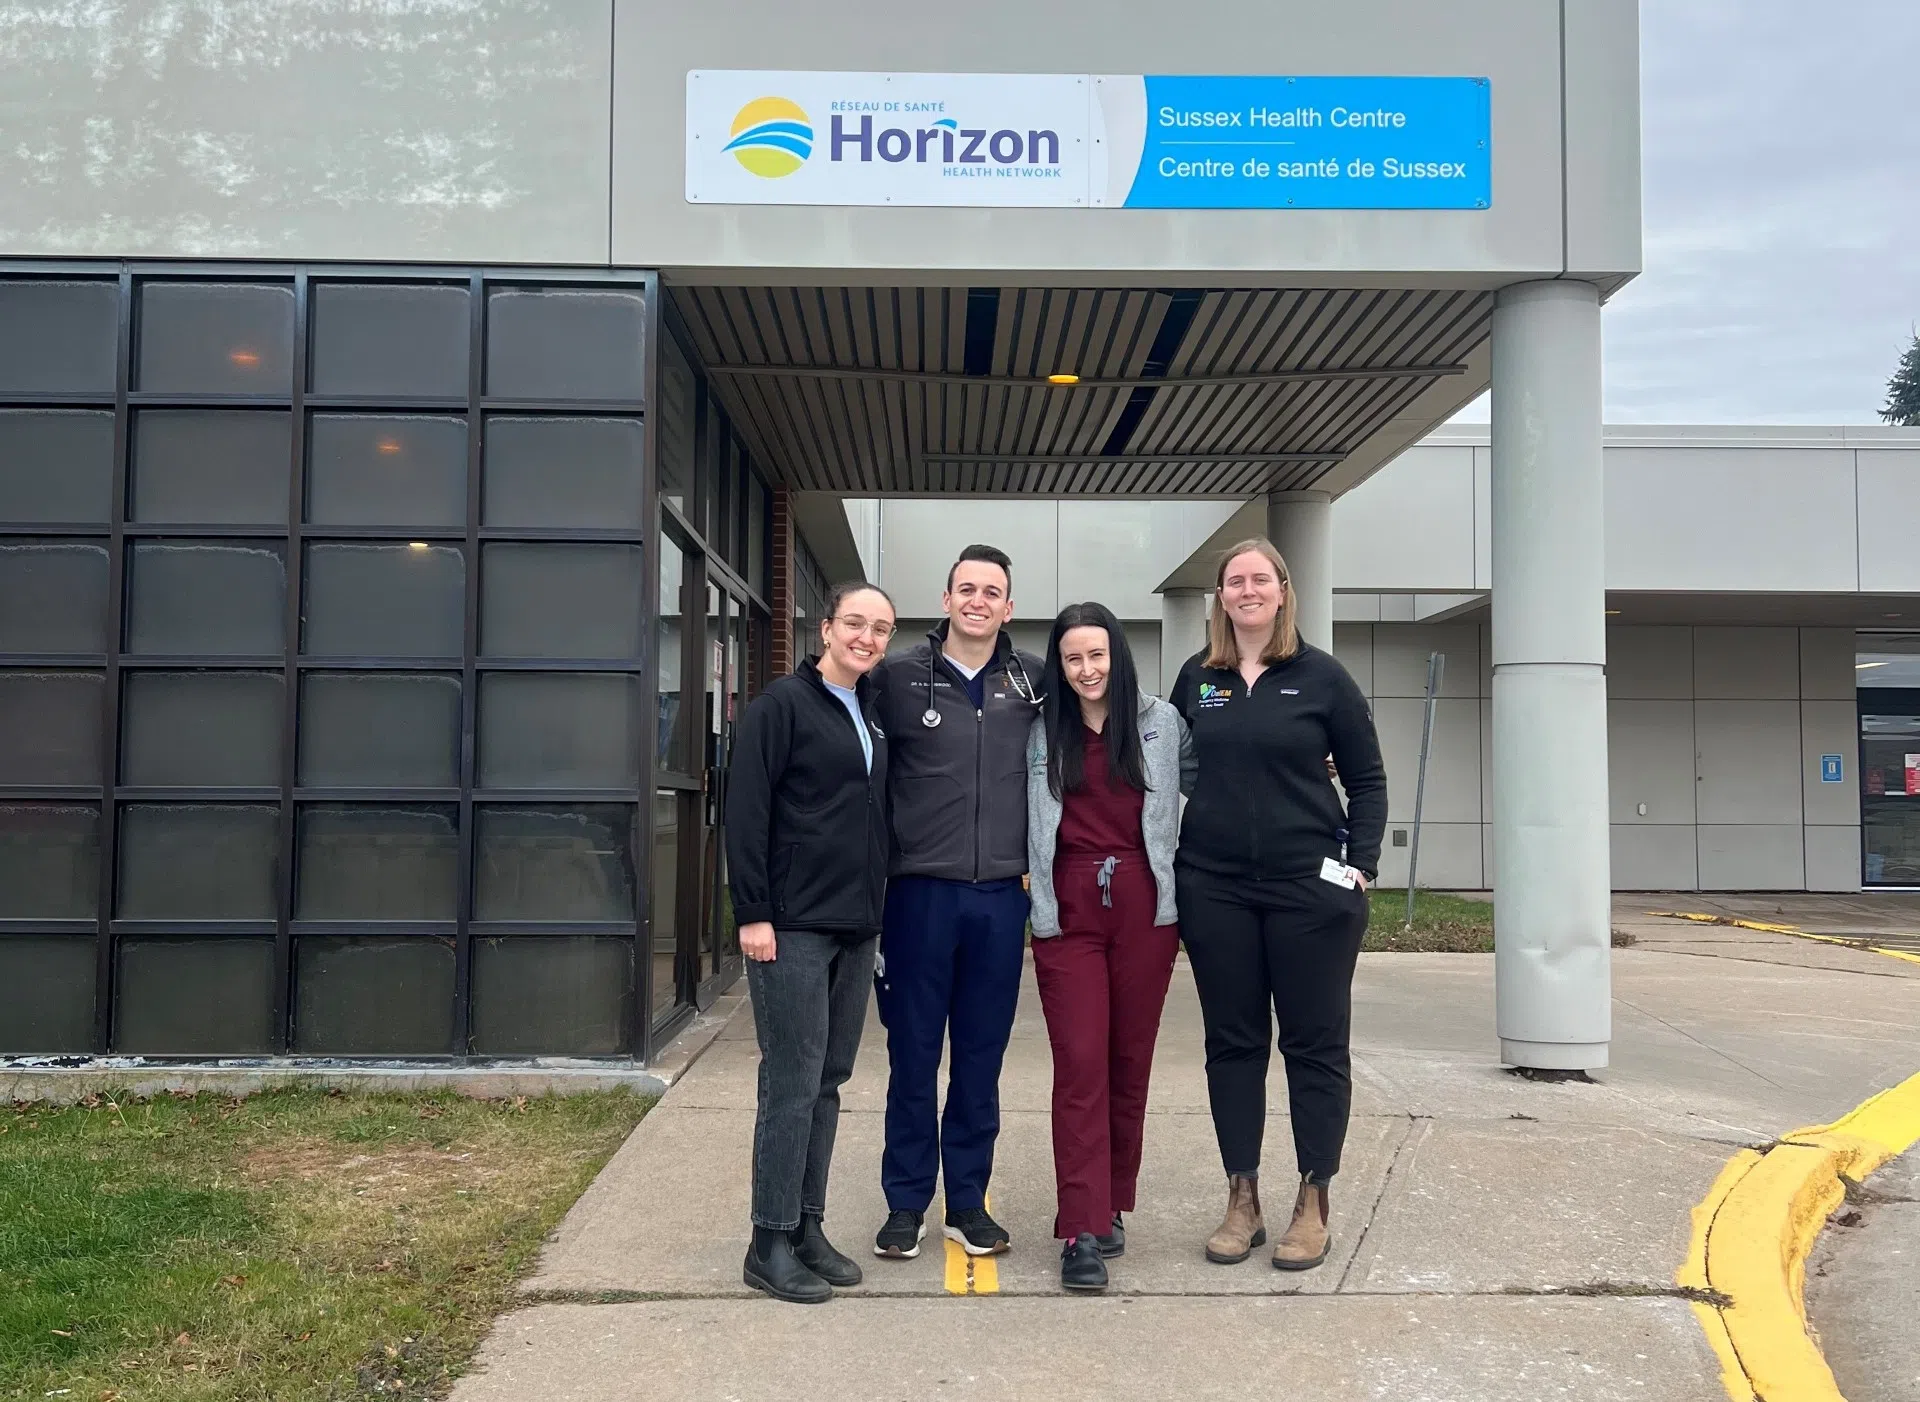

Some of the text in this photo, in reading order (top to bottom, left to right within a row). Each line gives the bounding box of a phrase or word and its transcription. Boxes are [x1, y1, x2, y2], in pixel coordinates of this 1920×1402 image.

[831, 100, 945, 113] RÉSEAU DE SANTÉ
[1159, 106, 1406, 128] Sussex Health Centre
[831, 115, 1059, 164] Horizon
[942, 167, 1062, 178] HEALTH NETWORK
[1159, 156, 1466, 179] Centre de santé de Sussex
